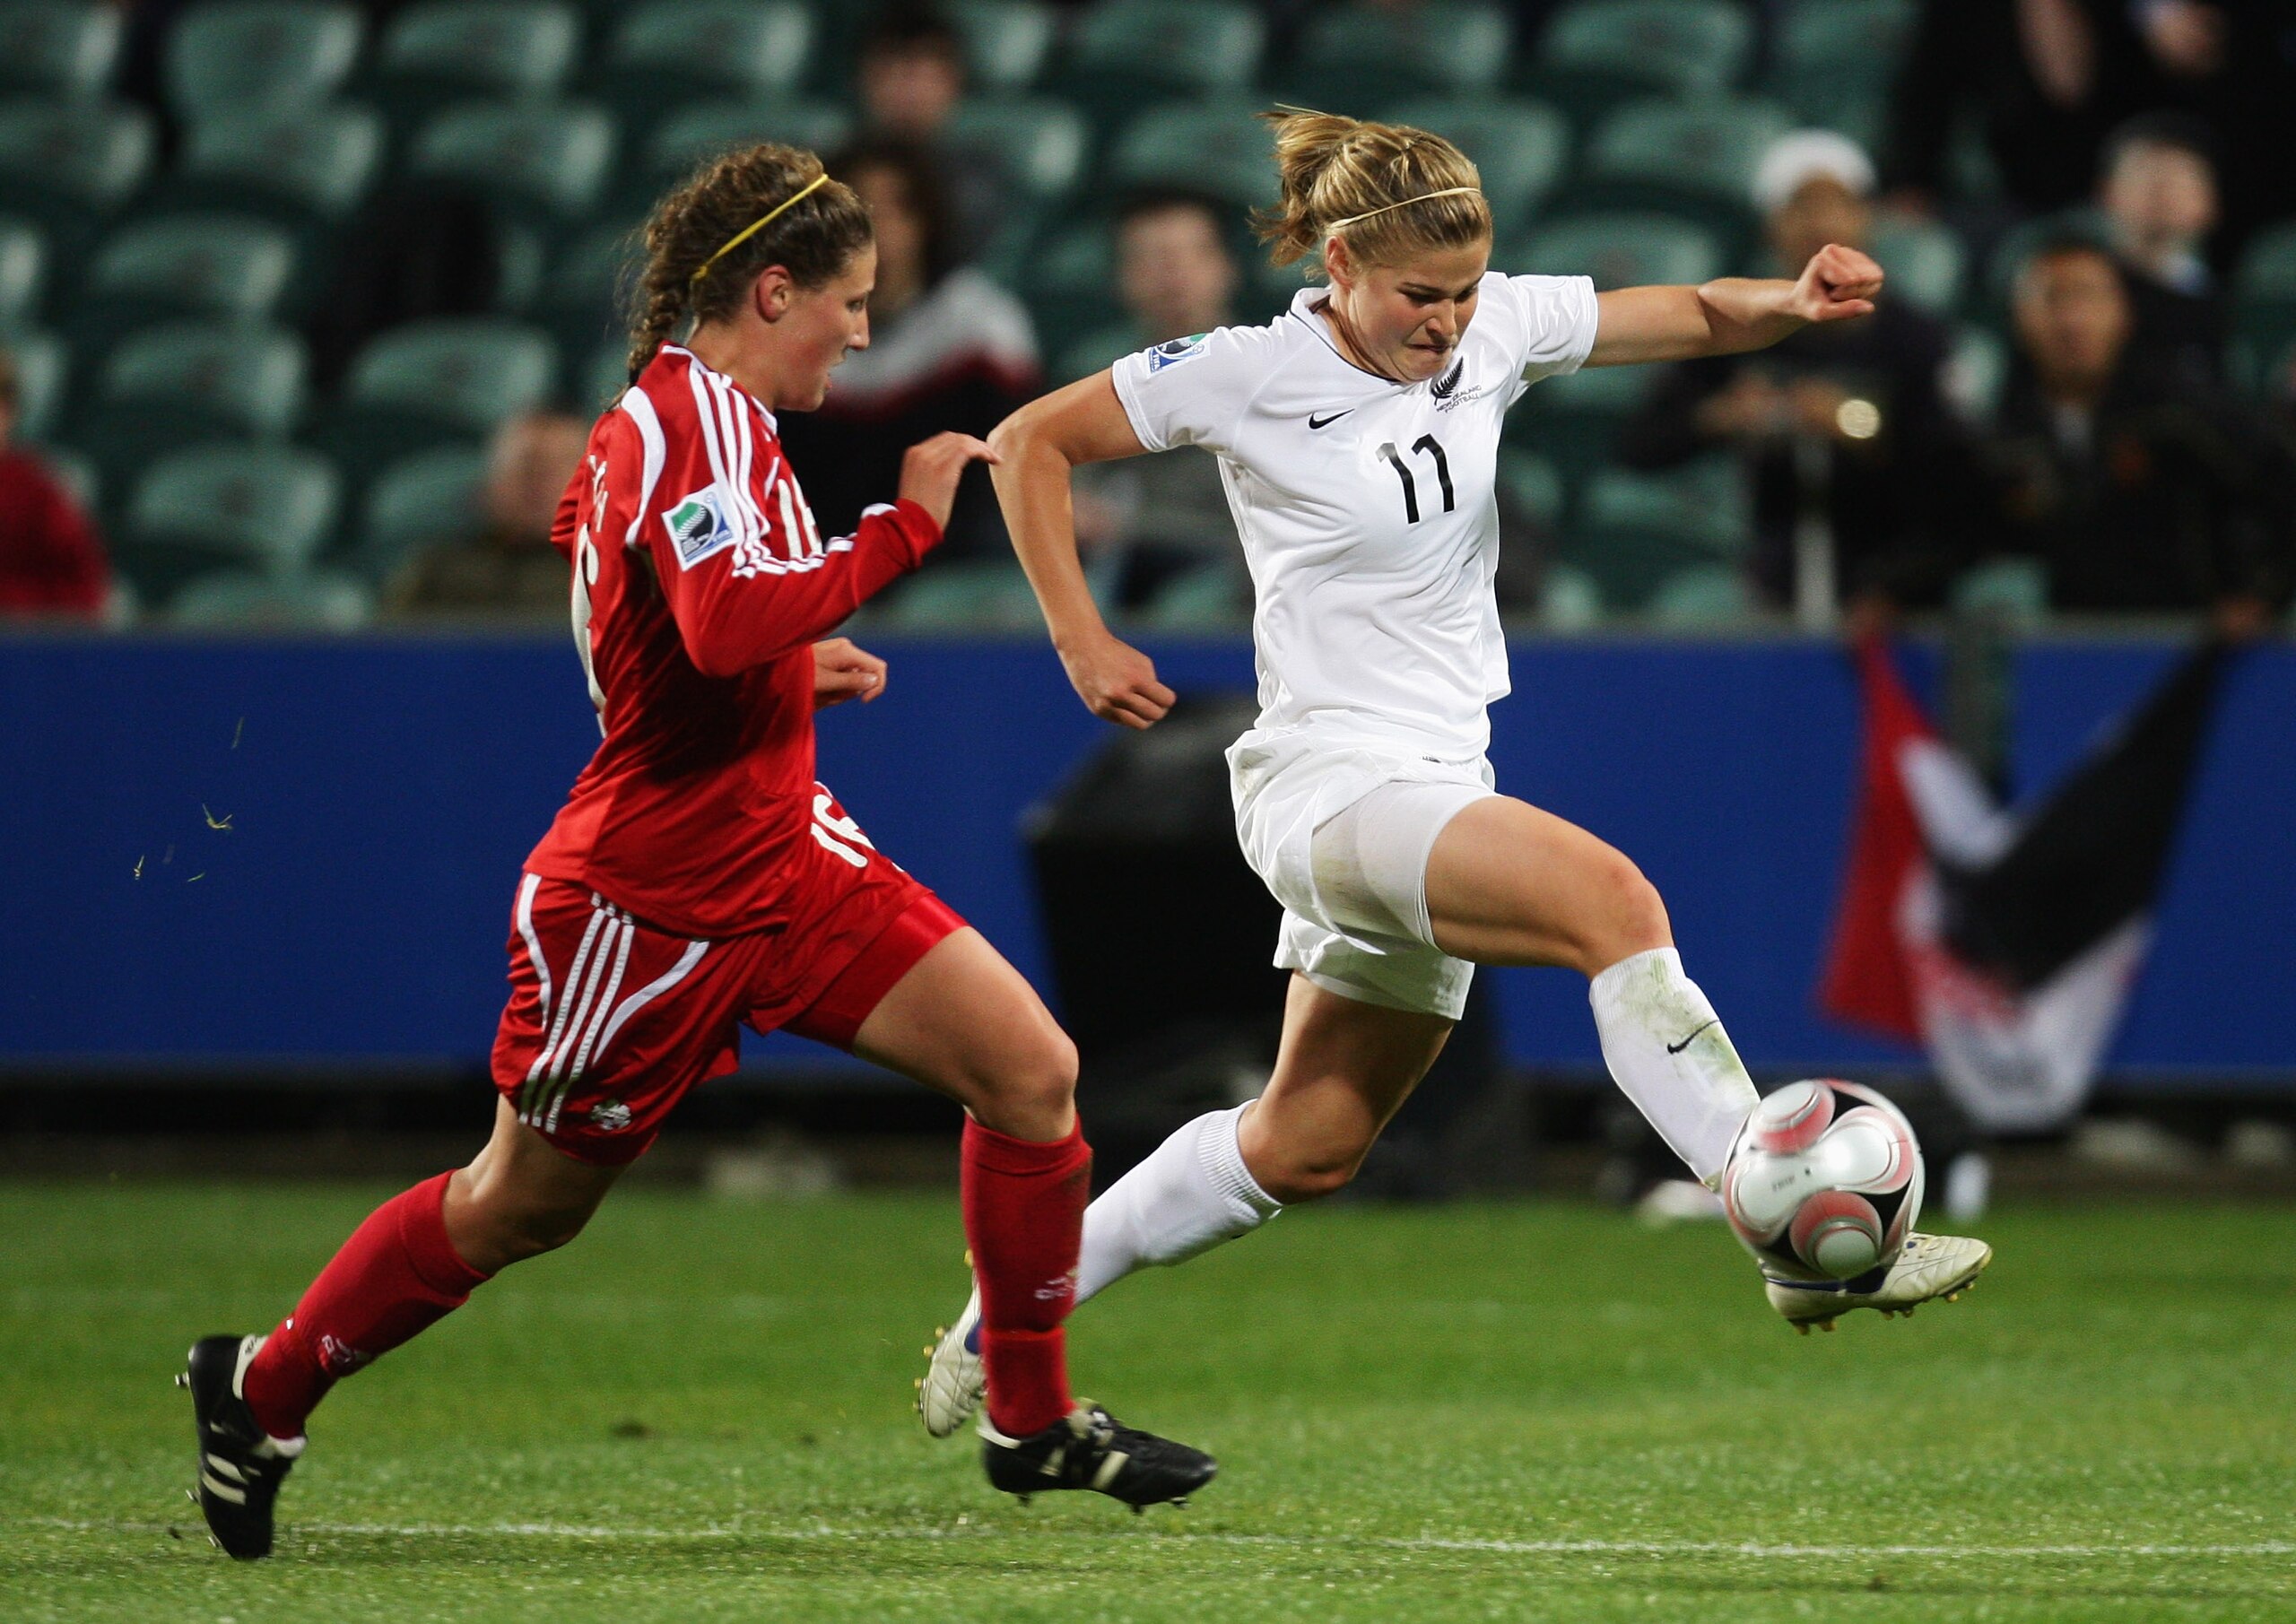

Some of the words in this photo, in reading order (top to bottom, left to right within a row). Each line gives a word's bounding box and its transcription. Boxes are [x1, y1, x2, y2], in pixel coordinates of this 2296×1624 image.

[1444, 393, 1480, 413] FOOTBALL
[1452, 385, 1482, 401] ZEALAND
[1374, 432, 1456, 525] 11
